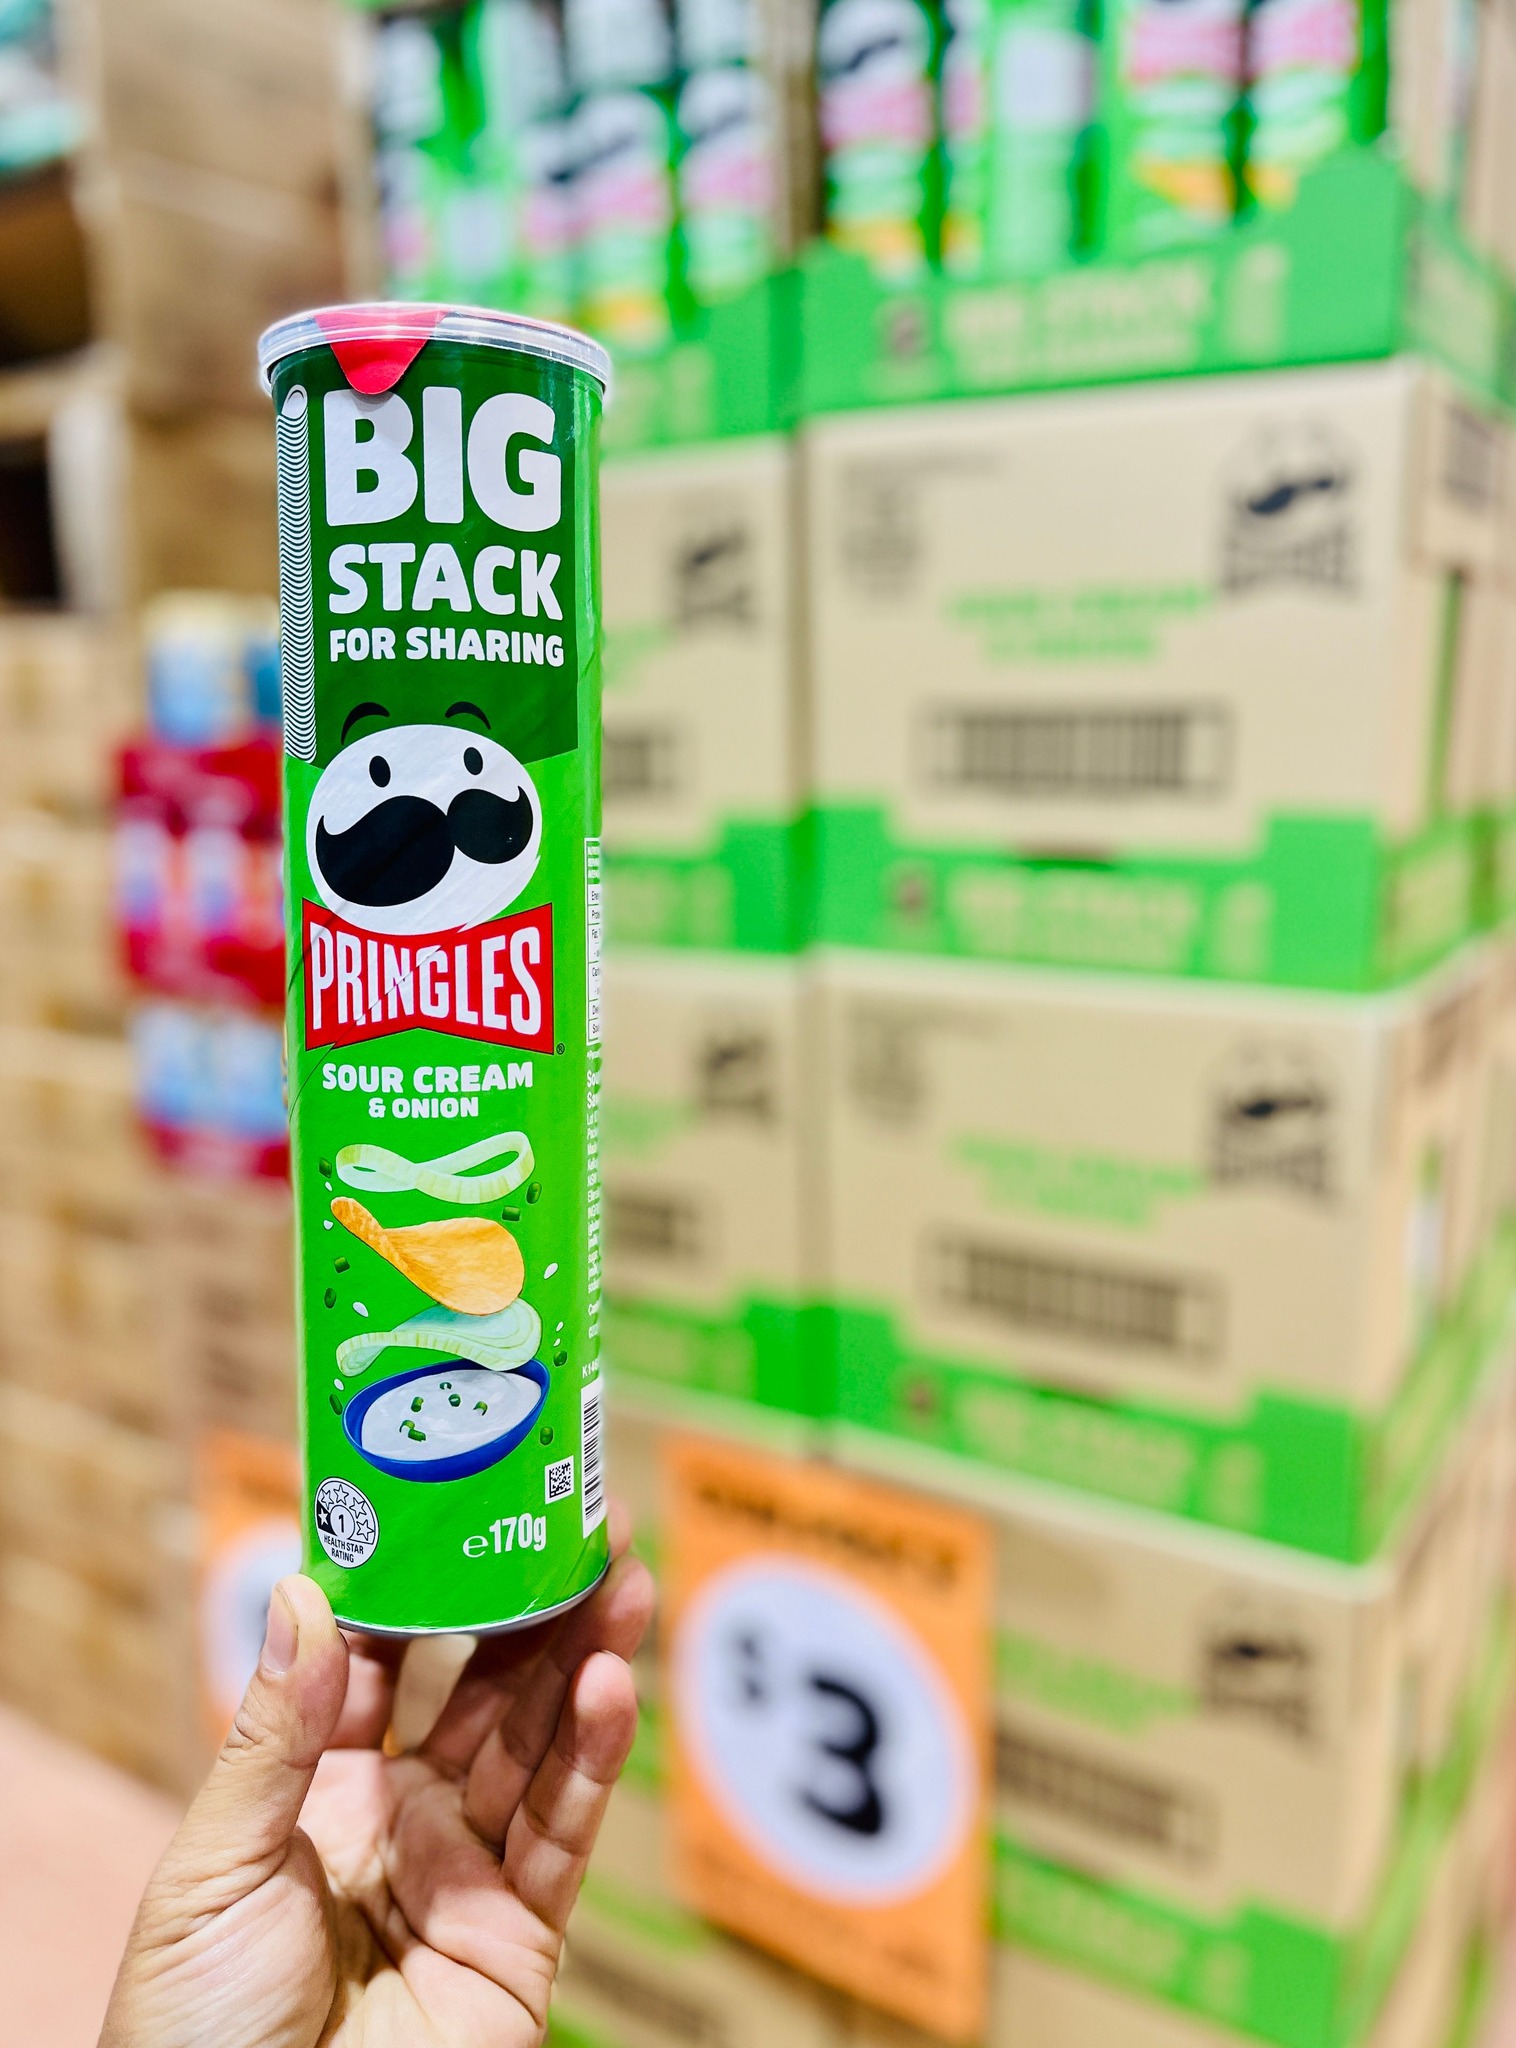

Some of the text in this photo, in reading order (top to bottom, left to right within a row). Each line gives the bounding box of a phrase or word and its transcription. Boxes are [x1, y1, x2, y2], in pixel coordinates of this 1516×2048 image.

[323, 387, 562, 532] BIG
[328, 542, 564, 621] STACK
[329, 627, 565, 667] FOR SHARING
[309, 921, 541, 1035] PRINGLES
[322, 1061, 533, 1093] SOUR CREAM
[368, 1096, 479, 1118] & ONION
[338, 1514, 345, 1533] 1
[323, 1534, 364, 1555] HEALTH STAR
[331, 1547, 354, 1563] RATING
